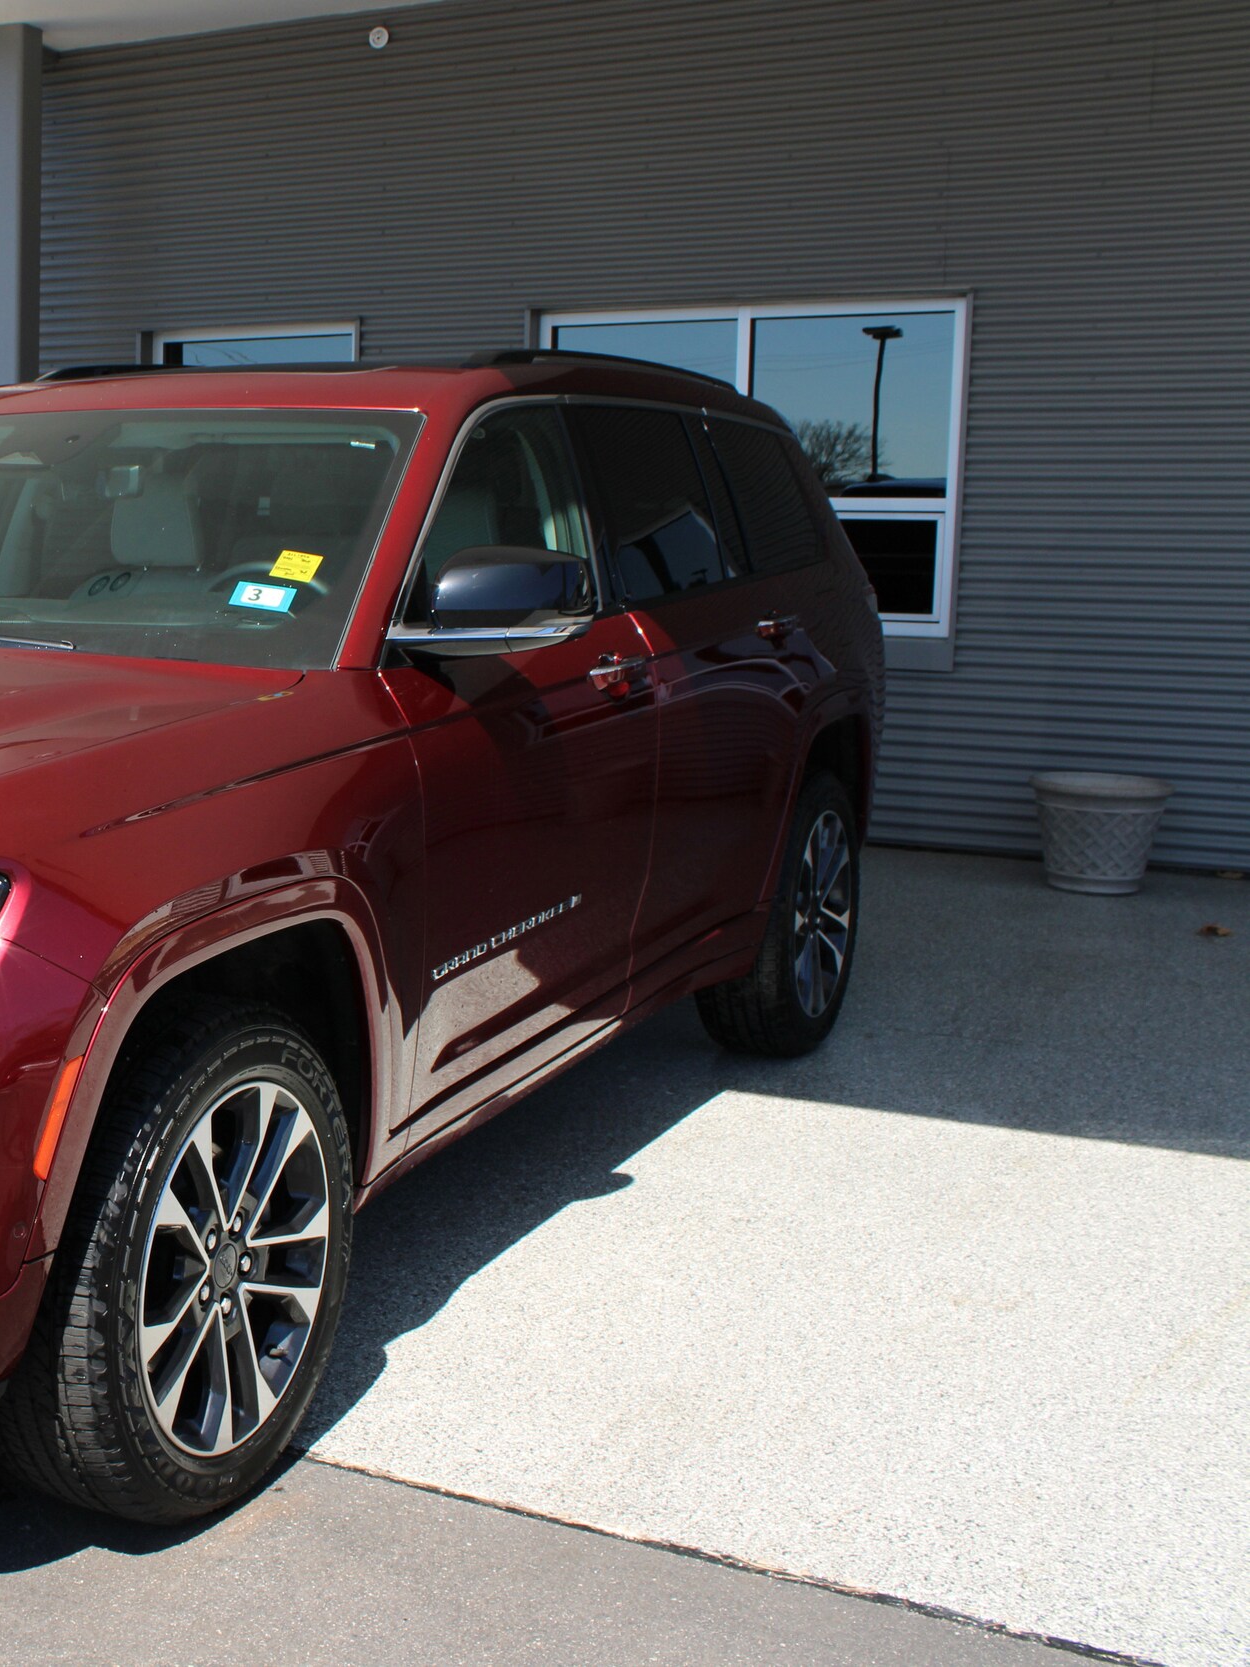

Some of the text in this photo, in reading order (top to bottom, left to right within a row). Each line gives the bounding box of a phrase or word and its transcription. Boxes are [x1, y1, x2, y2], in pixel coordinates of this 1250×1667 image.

[248, 588, 263, 602] 3
[431, 901, 570, 981] GRAND CHEROKEE
